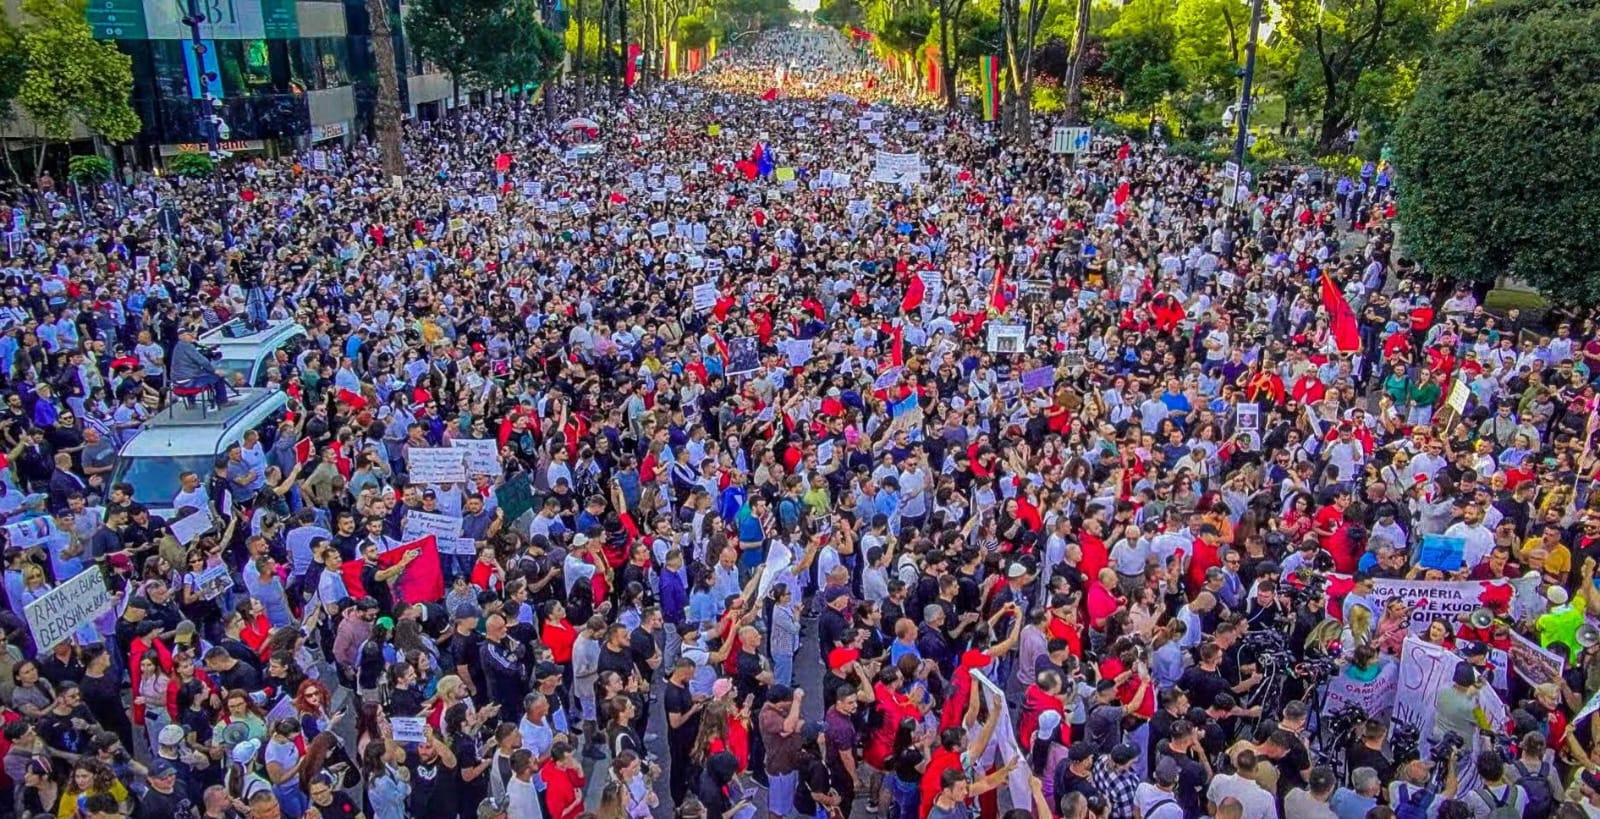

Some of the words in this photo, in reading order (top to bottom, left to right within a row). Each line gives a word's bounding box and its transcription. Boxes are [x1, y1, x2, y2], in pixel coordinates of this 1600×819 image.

[34, 589, 70, 625] RAMA
[1371, 587, 1395, 596] NGA
[1399, 587, 1463, 600] ÇAMËRIA
[40, 604, 87, 648] BERISHA
